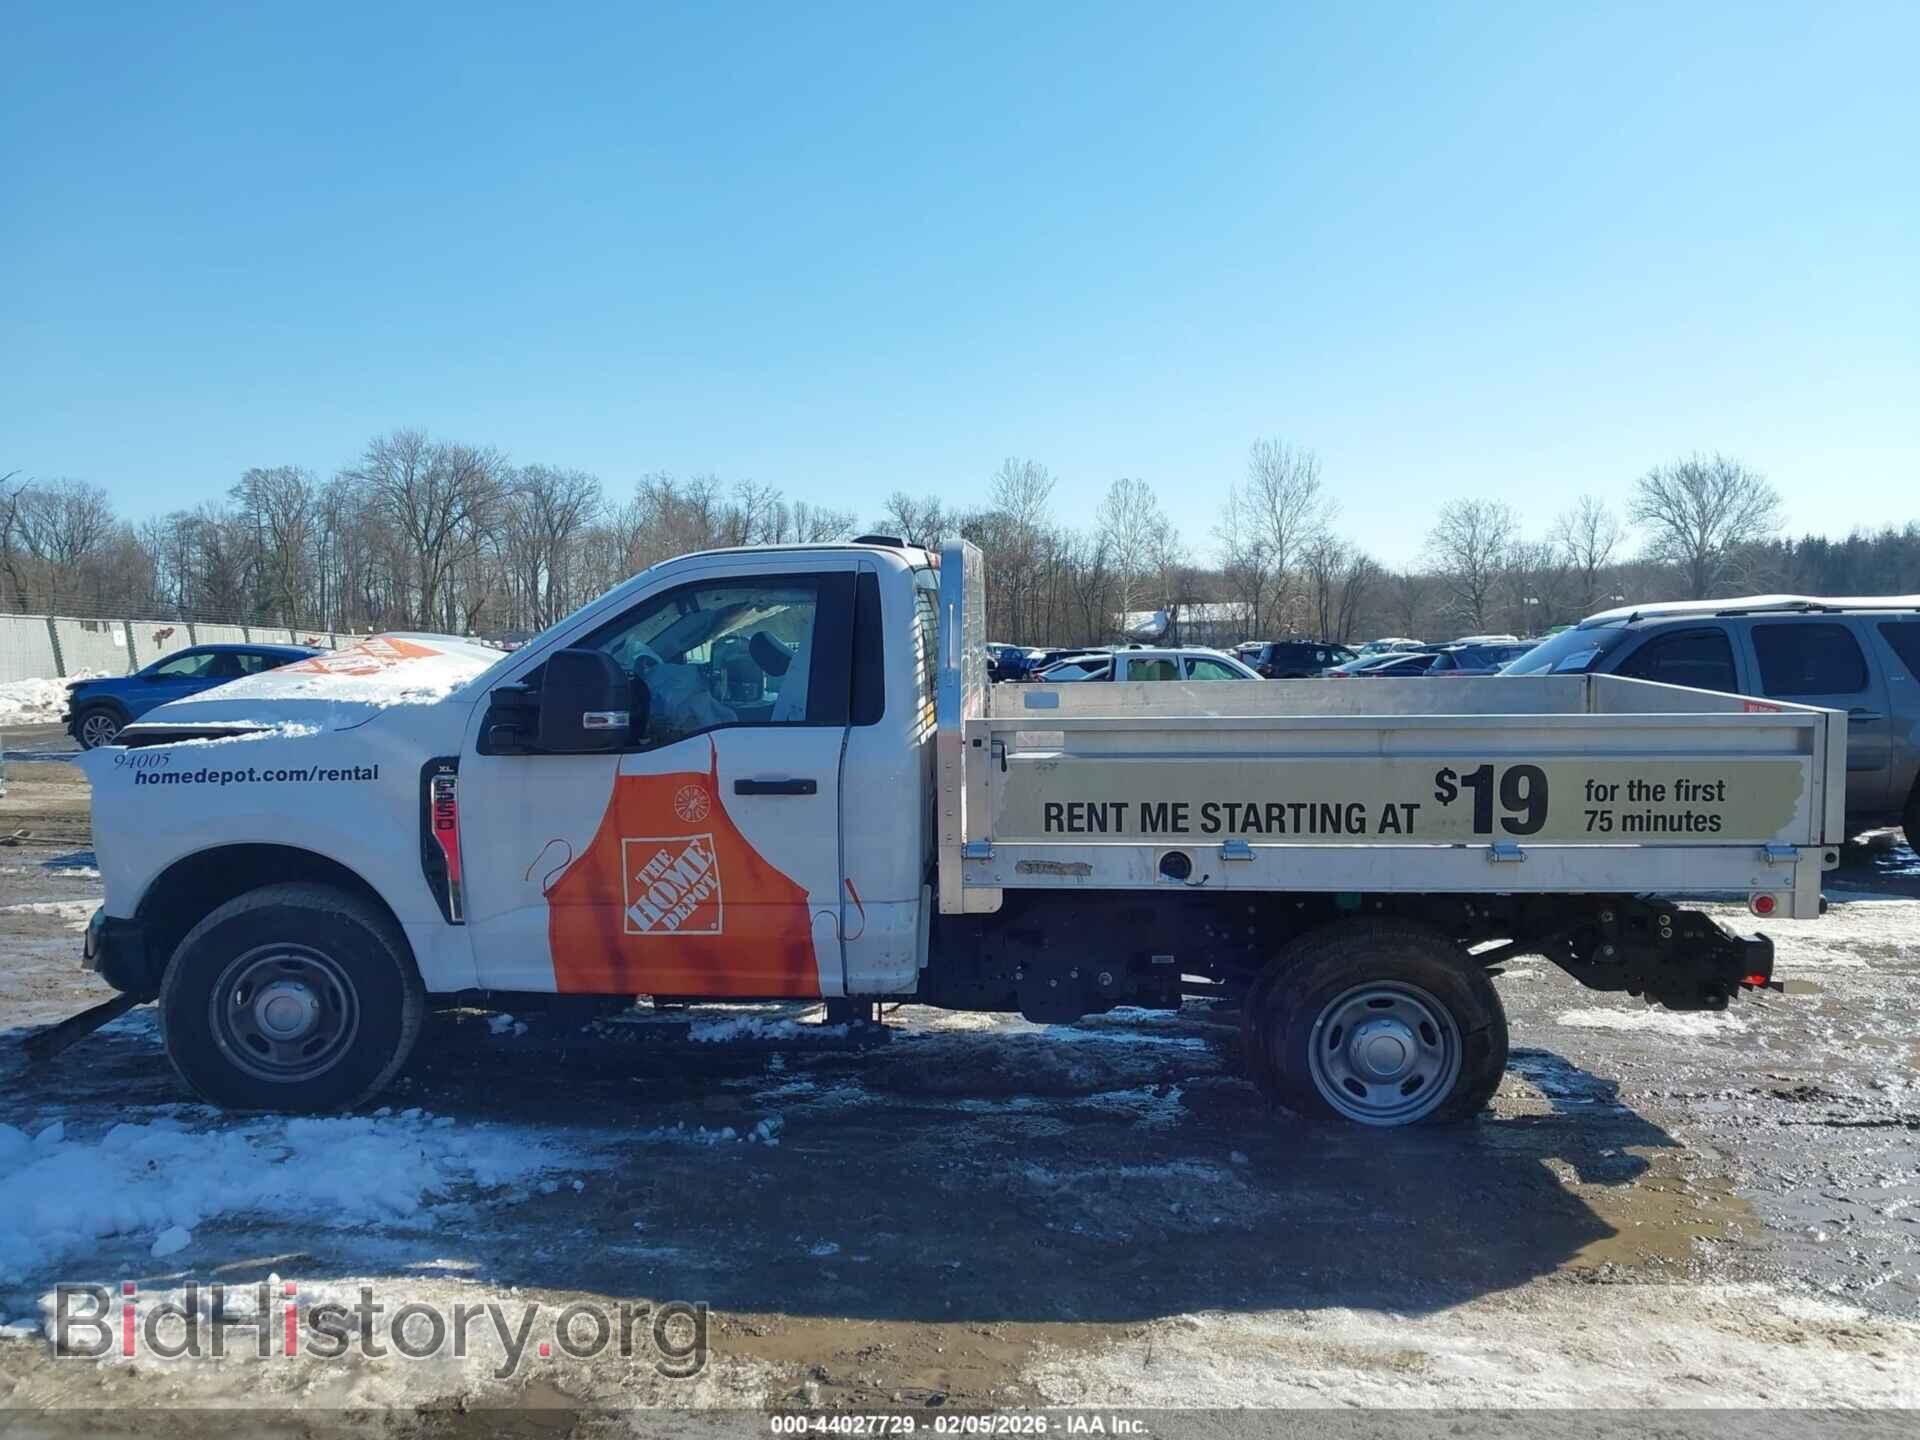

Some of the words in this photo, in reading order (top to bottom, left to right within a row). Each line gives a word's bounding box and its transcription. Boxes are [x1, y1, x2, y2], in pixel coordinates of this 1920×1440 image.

[113, 753, 172, 769] 94005
[134, 763, 379, 786] homedepot.com/rental
[1044, 802, 1128, 833] RENT
[1141, 802, 1190, 833] ME
[1201, 802, 1367, 834] STARTING
[1378, 803, 1420, 834] AT
[1434, 764, 1549, 836] $19
[1585, 778, 1619, 803] for
[1627, 778, 1667, 803] the
[1674, 778, 1726, 803] first
[1585, 809, 1614, 833] 75
[1622, 808, 1722, 833] minutes
[635, 849, 674, 887] THE
[628, 839, 714, 932] HOME
[662, 872, 717, 931] DEPOT
